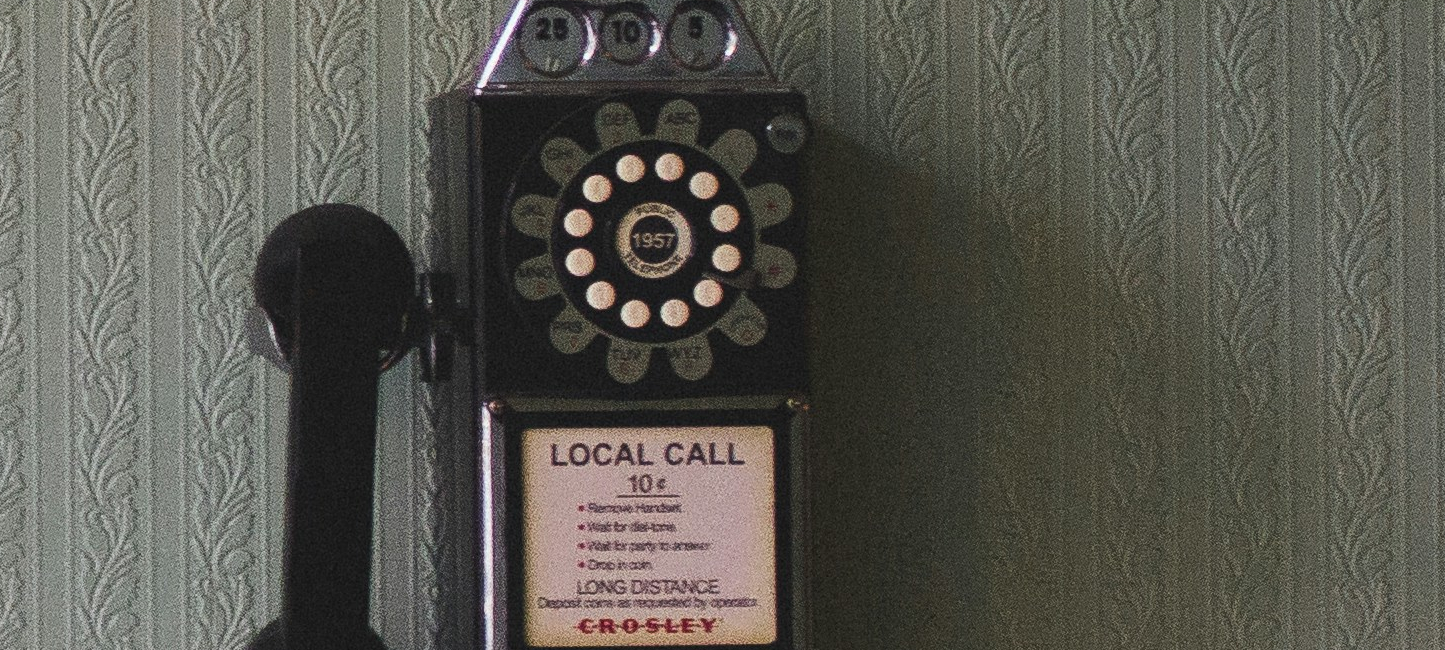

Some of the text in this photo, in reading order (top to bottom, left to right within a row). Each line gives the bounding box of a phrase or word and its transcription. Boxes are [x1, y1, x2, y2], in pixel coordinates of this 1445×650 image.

[536, 17, 569, 41] 25
[611, 20, 640, 44] 10
[688, 16, 703, 39] 5
[603, 113, 630, 125] DEF
[665, 112, 697, 125] ABC
[636, 204, 676, 219] PUBLIC
[632, 232, 676, 249] 1957
[623, 251, 684, 273] TELEPHONE
[551, 442, 745, 466] LOCAL CALL
[627, 473, 653, 493] 10
[588, 502, 633, 514] Remove
[587, 522, 611, 533] Wait
[614, 521, 627, 533] for
[587, 541, 611, 552] Wait
[613, 540, 627, 552] for
[629, 541, 656, 553] party
[658, 541, 670, 551] to
[587, 559, 616, 570] Drop
[617, 559, 627, 570] in
[576, 579, 720, 595] LONG DISTANCE
[537, 596, 581, 609] Deposit
[584, 599, 612, 609] coins
[617, 599, 631, 609] as
[632, 598, 691, 610] requested
[693, 598, 707, 611] by
[577, 617, 717, 634] CROSLEY
